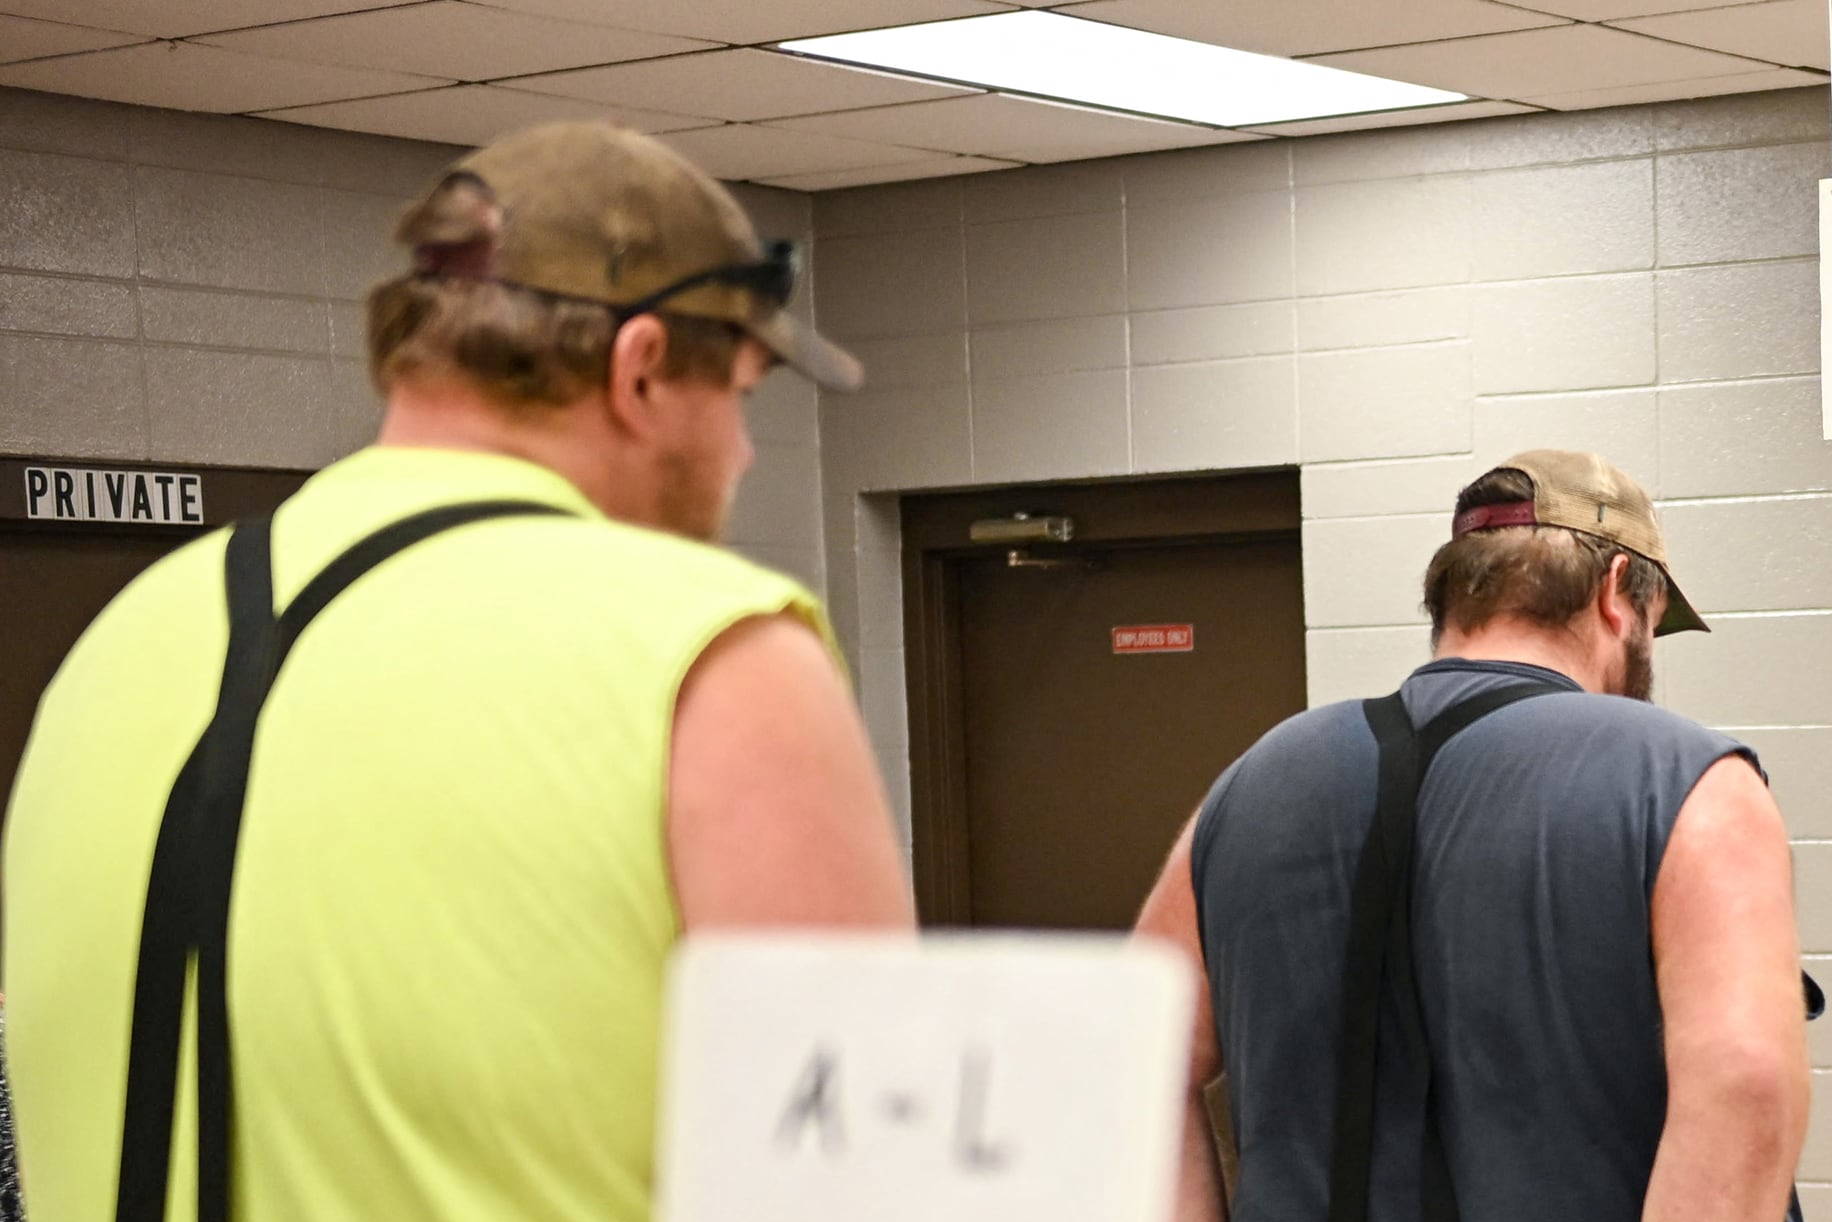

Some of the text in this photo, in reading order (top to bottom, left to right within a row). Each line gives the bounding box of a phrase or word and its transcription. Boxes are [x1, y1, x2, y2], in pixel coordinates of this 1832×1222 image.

[27, 469, 200, 522] PRIVATE
[776, 1042, 847, 1158] A
[954, 1046, 1013, 1172] L
